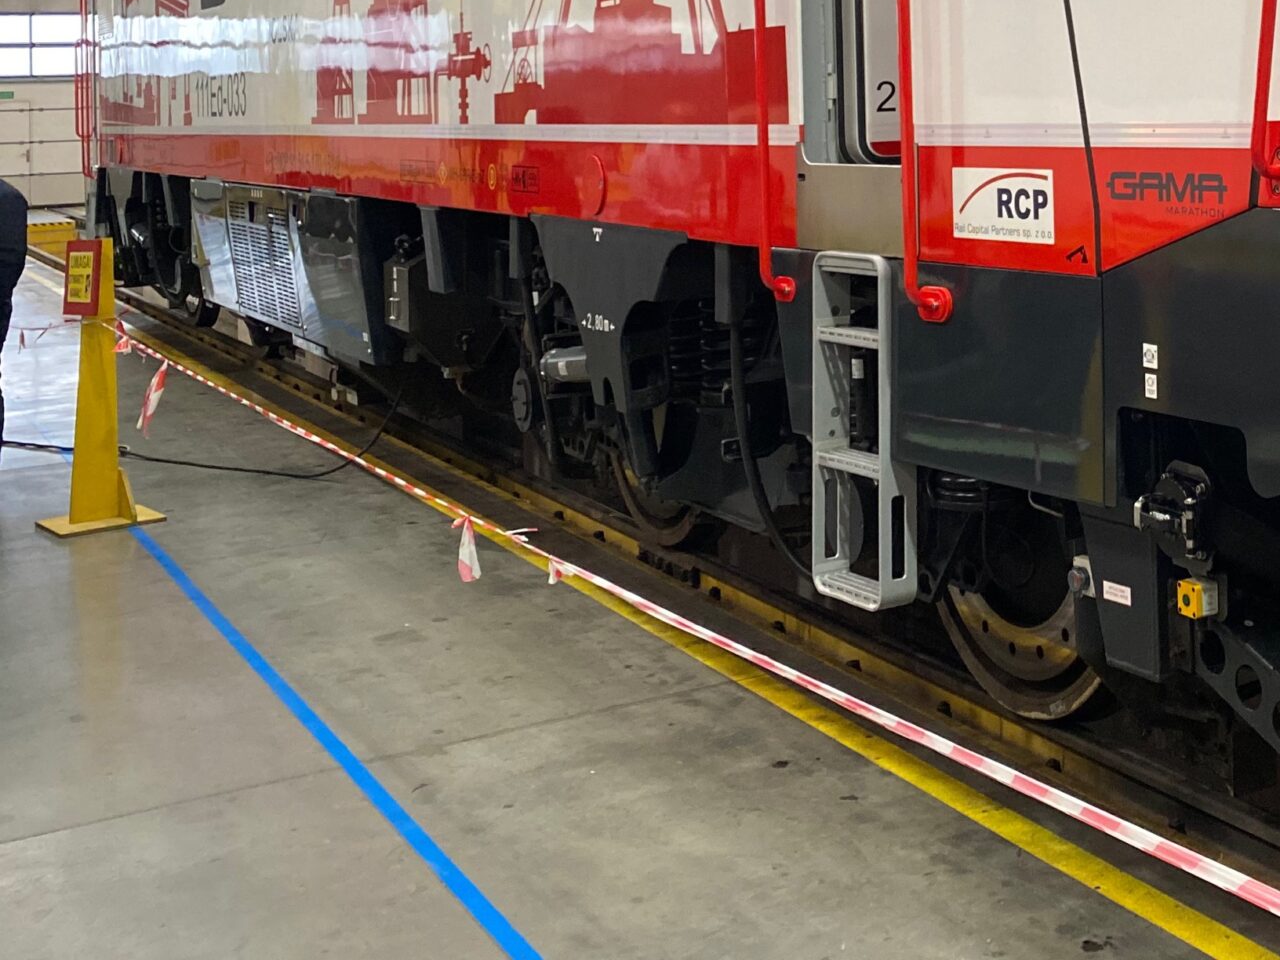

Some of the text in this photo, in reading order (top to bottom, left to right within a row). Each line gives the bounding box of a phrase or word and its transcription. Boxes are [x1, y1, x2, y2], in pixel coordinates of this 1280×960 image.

[195, 71, 247, 118] 111Ed-033
[876, 80, 897, 113] 2
[996, 187, 1049, 220] RCP
[1106, 171, 1228, 205] GAMA
[1165, 206, 1225, 218] MARATHON
[954, 222, 966, 233] Rail
[967, 223, 989, 236] Capital
[991, 224, 1021, 238] Partners
[1022, 229, 1033, 240] sp.
